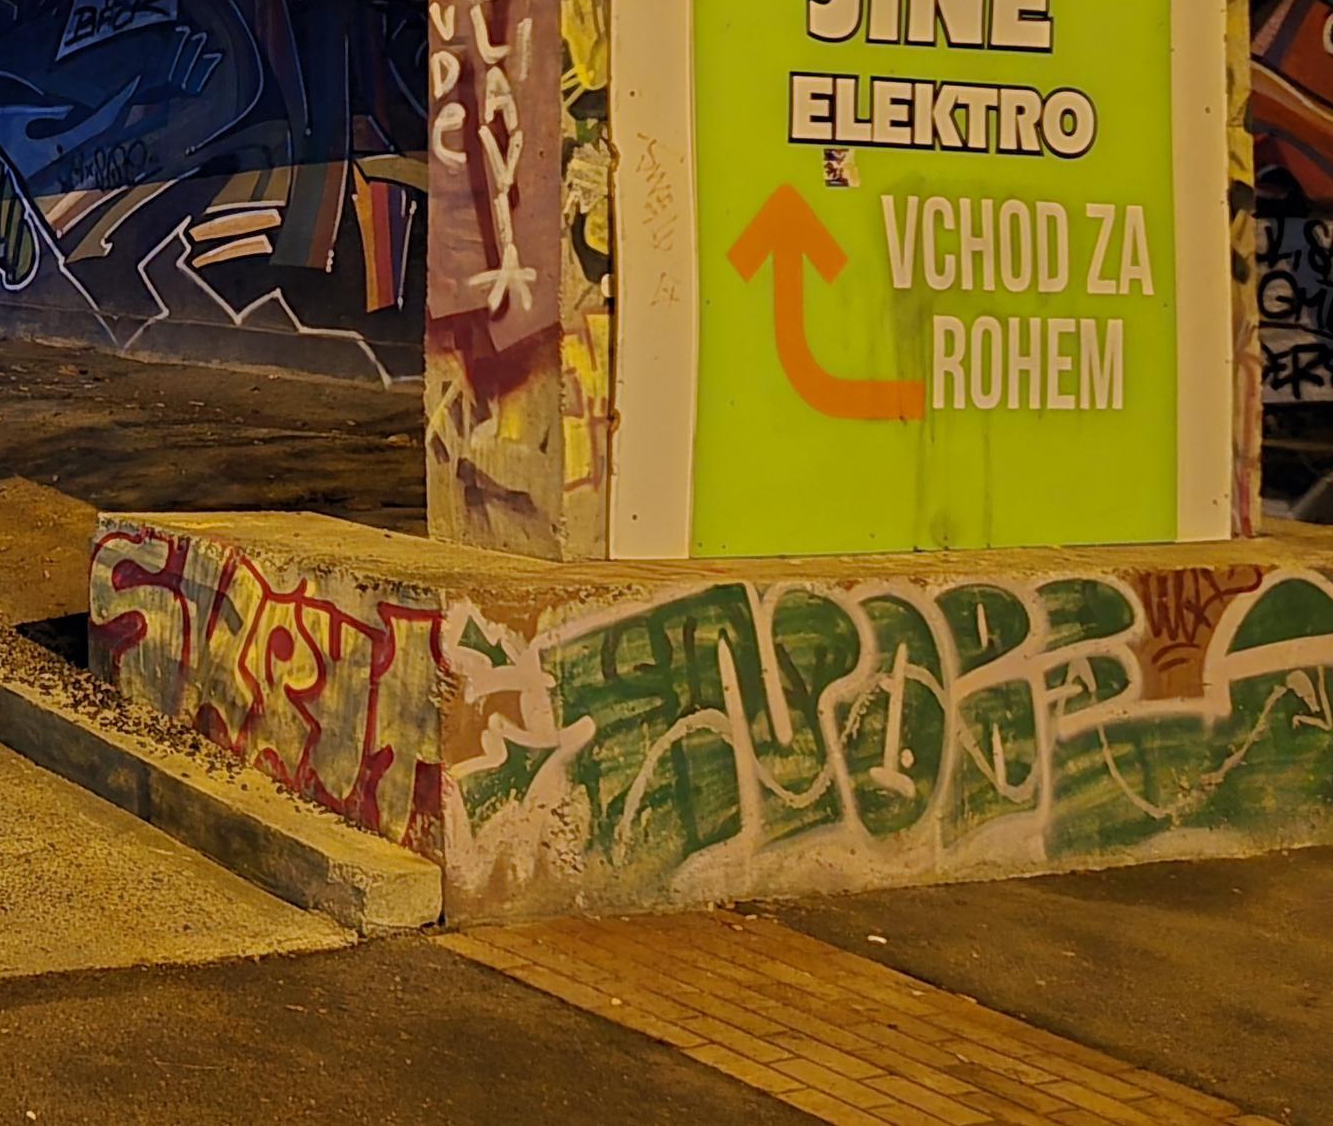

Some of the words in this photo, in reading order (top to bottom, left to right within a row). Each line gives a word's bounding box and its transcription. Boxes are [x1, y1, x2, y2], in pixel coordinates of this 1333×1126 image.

[788, 72, 1097, 159] ELEKTRO
[880, 194, 1071, 294] VCHOD
[1085, 203, 1155, 296] ZA
[933, 314, 1124, 411] ROHEM
